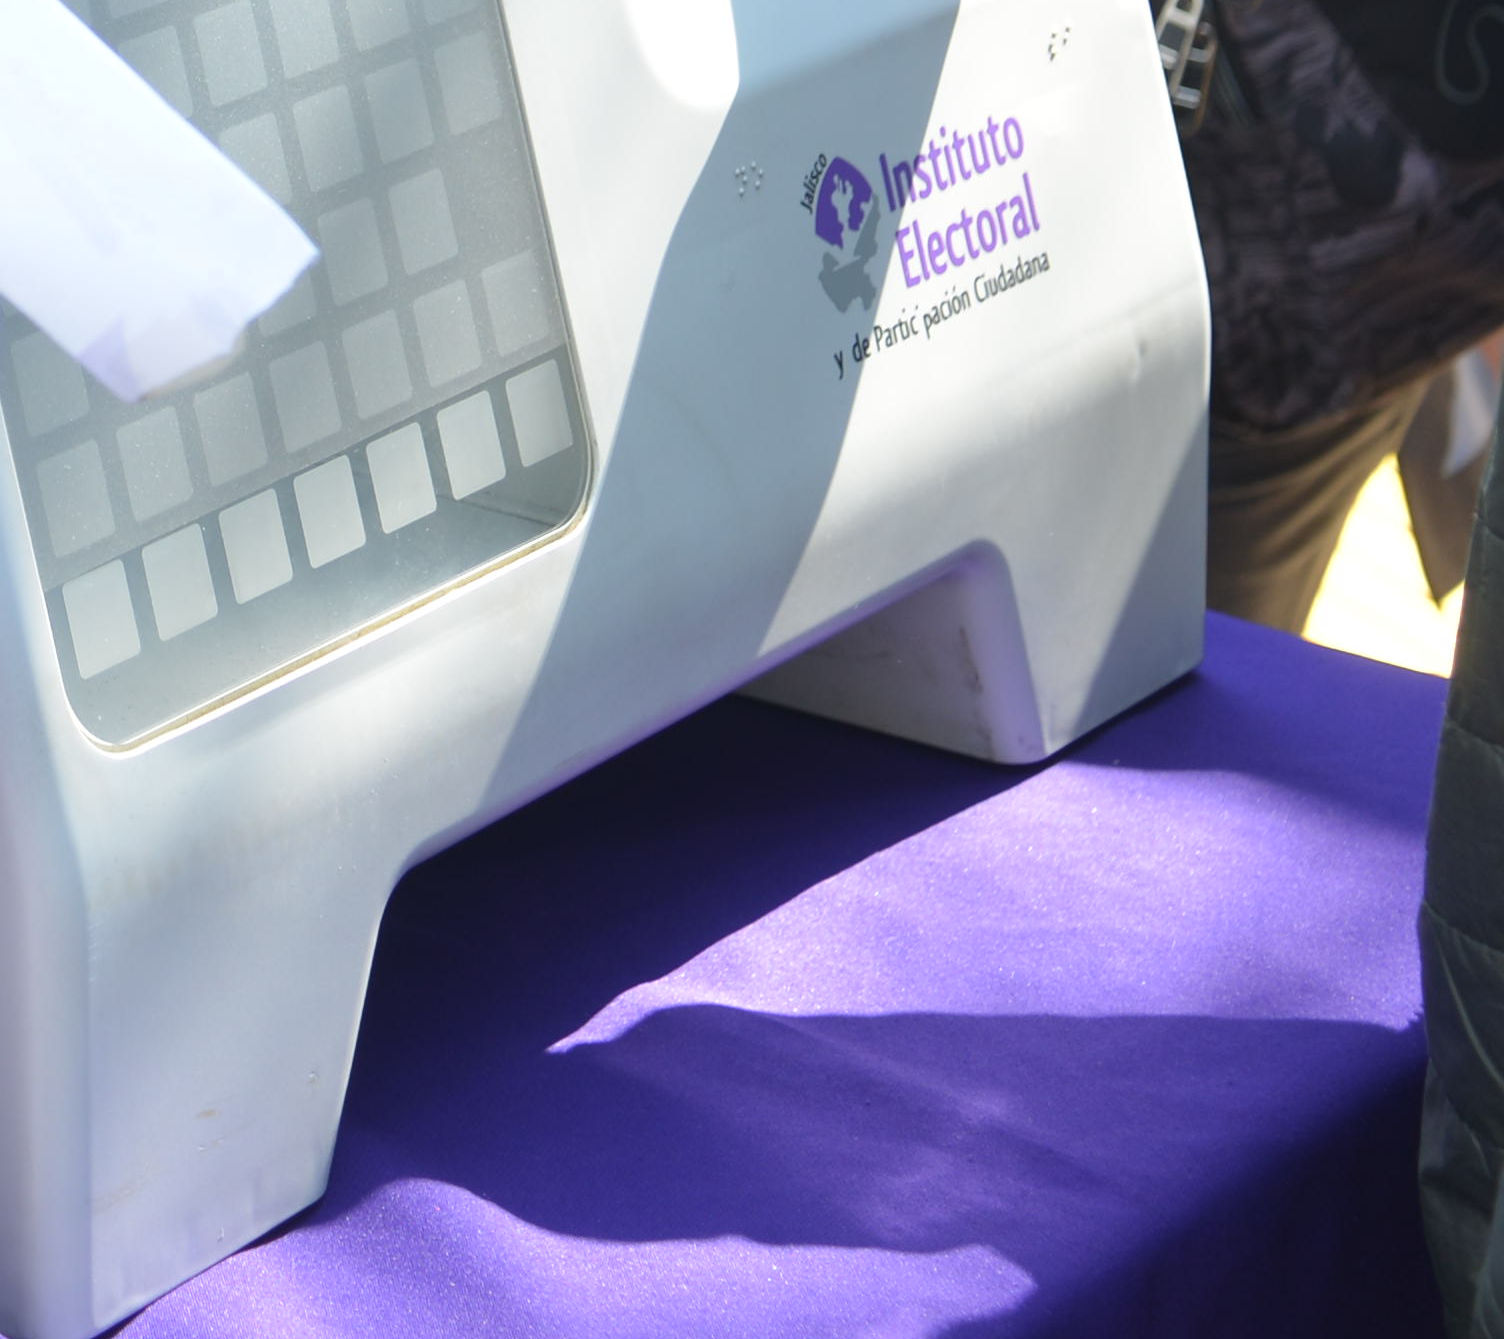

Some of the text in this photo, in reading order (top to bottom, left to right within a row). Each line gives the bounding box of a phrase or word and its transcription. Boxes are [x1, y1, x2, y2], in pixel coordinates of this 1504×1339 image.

[800, 153, 828, 215] Jalisco
[879, 115, 1025, 213] Instituto
[895, 171, 1041, 289] Electoral
[833, 349, 844, 381] y
[852, 333, 871, 364] de
[973, 251, 1051, 304] Ciudadana
